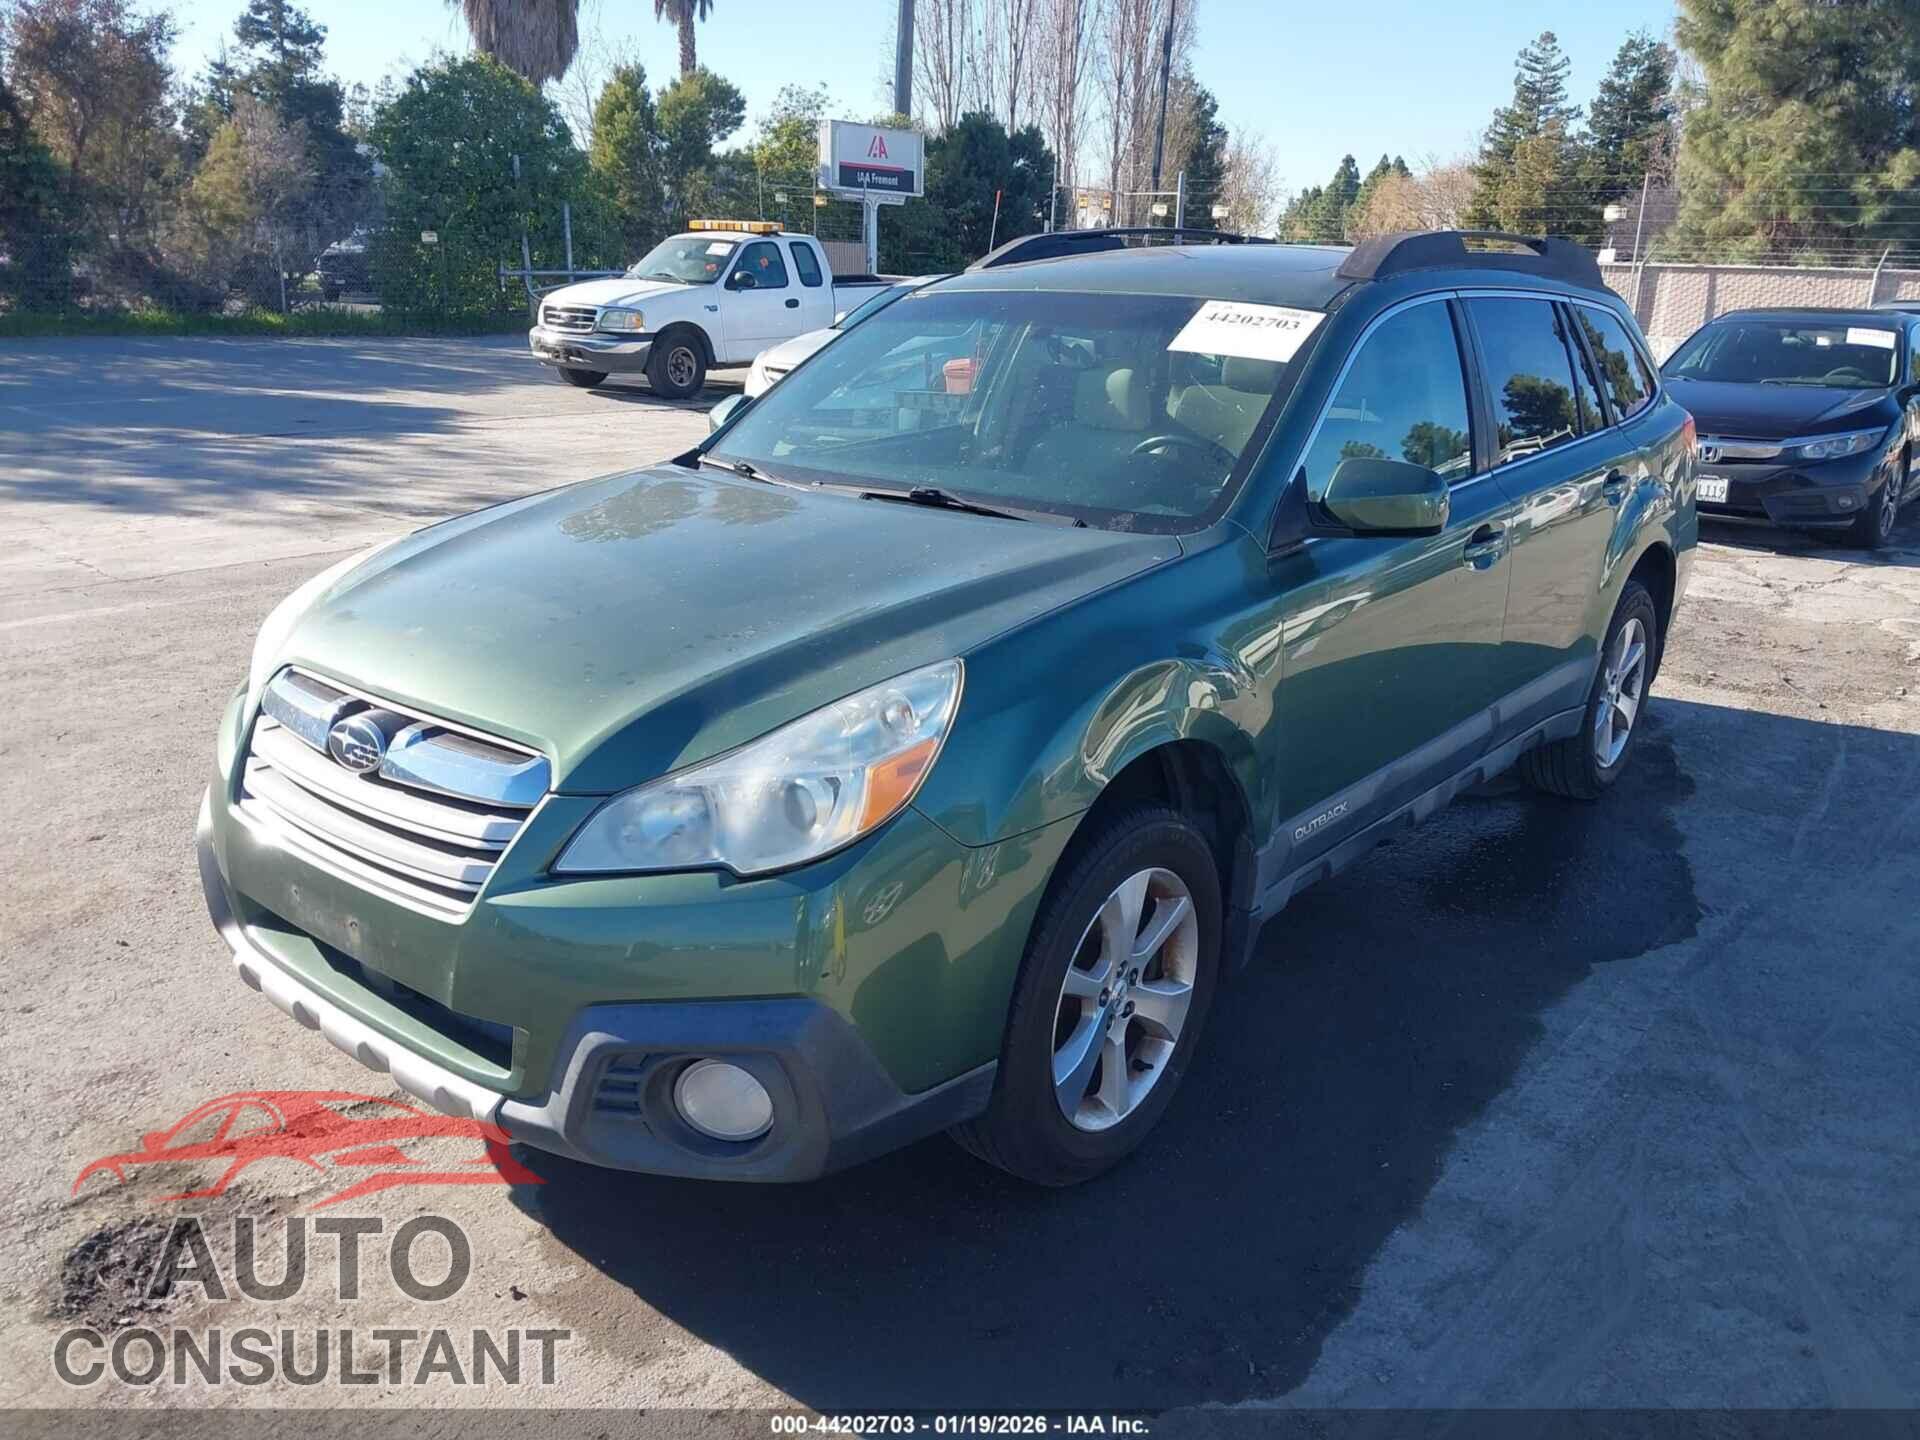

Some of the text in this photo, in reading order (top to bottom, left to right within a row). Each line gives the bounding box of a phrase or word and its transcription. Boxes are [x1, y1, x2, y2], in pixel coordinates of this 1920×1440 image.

[871, 172, 899, 186] Fremont
[1204, 312, 1301, 331] 44202703
[1294, 801, 1349, 840] OUTBACK
